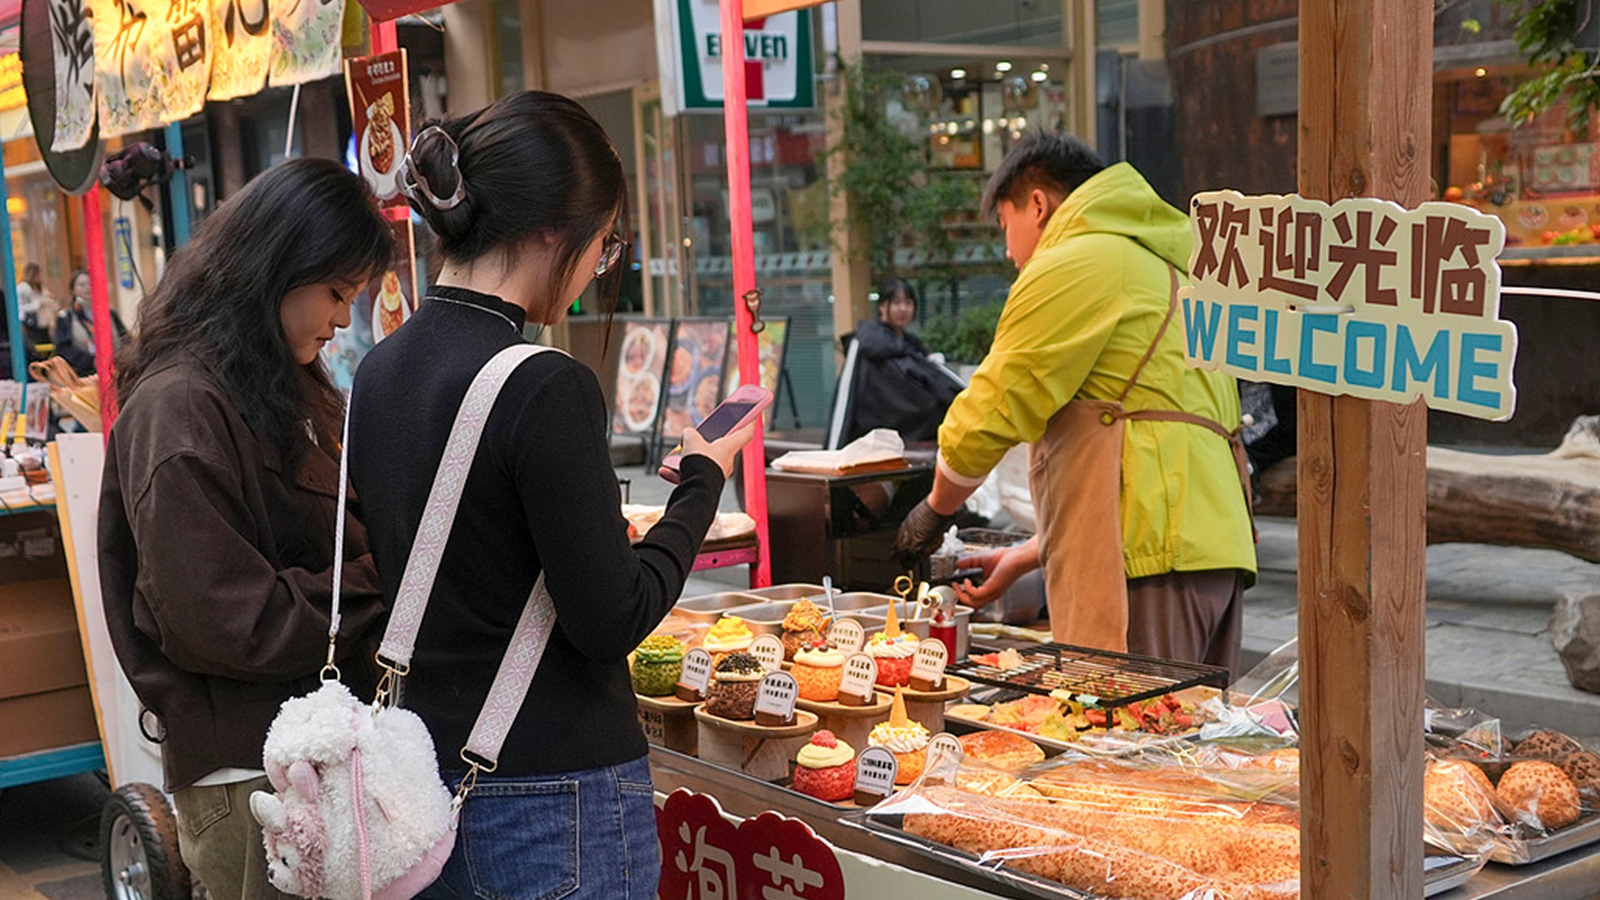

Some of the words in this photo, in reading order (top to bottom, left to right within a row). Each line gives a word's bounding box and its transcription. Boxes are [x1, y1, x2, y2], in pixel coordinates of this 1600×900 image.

[706, 33, 788, 59] EVEn
[1193, 202, 1490, 317] 欢迎光临
[1183, 298, 1503, 409] WELCOME
